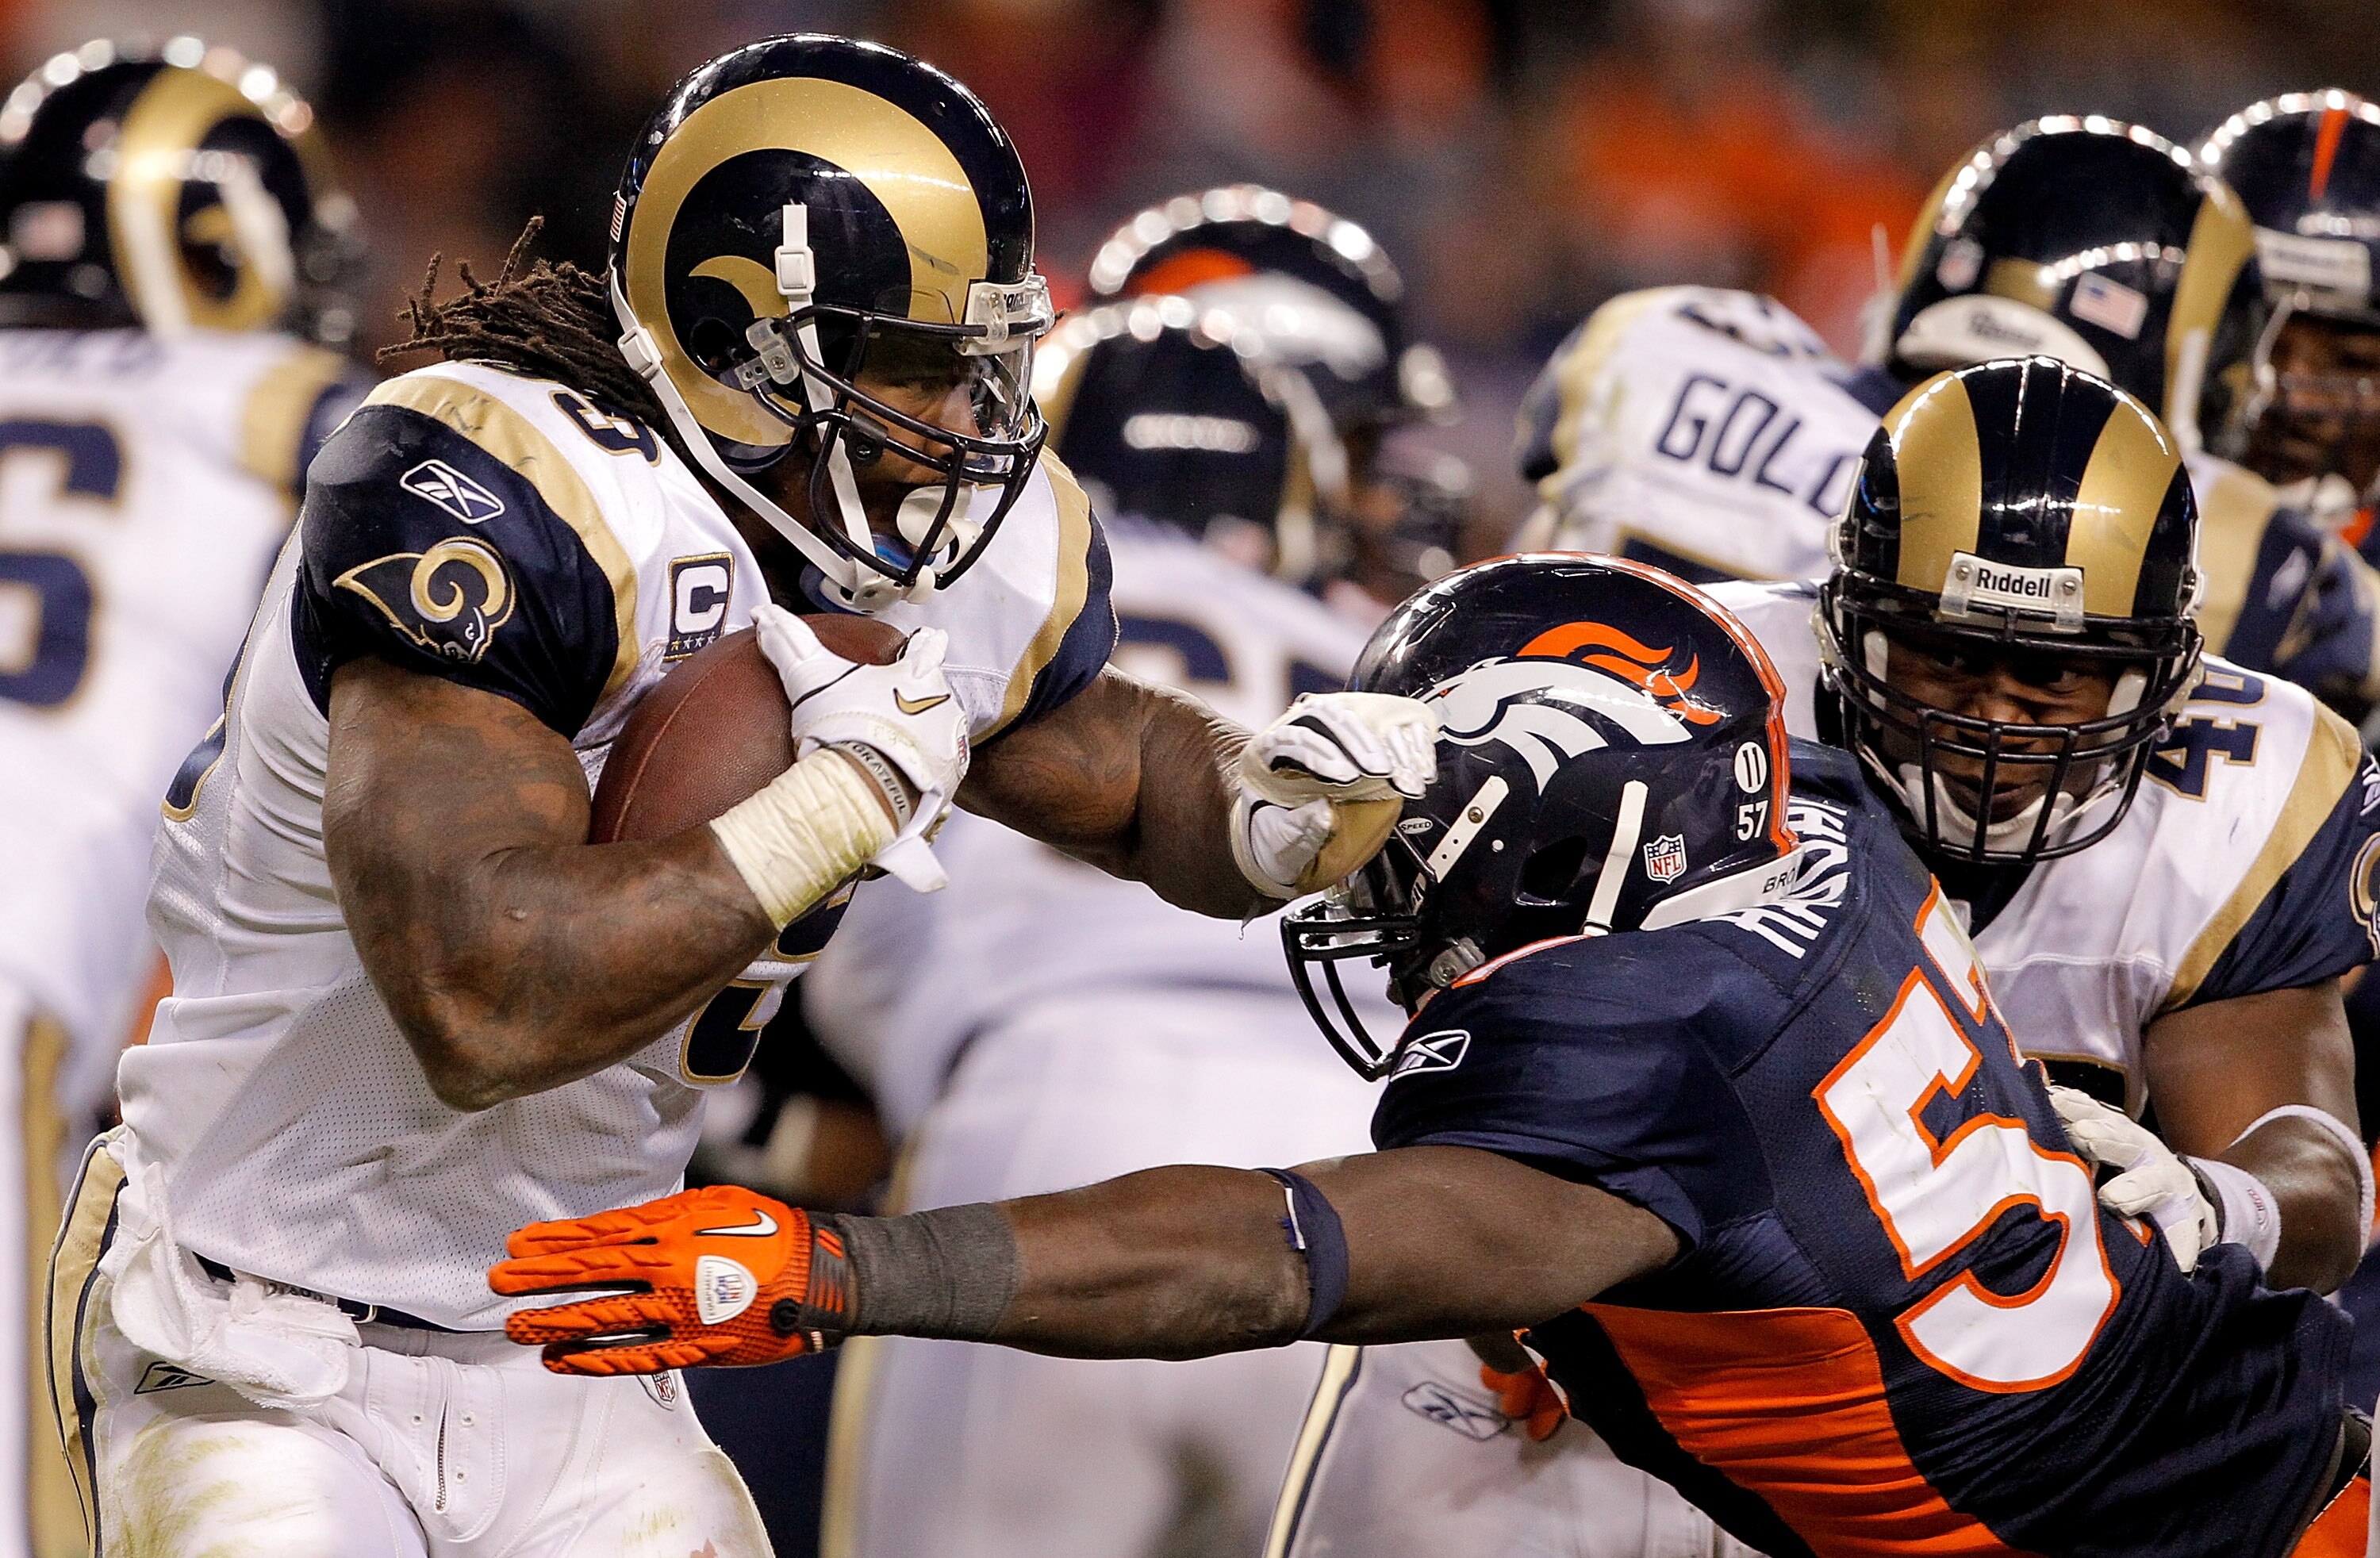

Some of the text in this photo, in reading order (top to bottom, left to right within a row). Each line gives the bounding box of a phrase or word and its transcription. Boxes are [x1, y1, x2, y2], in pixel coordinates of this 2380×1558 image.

[674, 564, 728, 635] C
[1976, 568, 2051, 597] Riddell
[852, 743, 907, 815] GRATEFUL
[1743, 746, 1762, 789] 11
[1400, 820, 1432, 831] SPEED
[1737, 799, 1769, 841] 57
[1651, 854, 1681, 876] NFL
